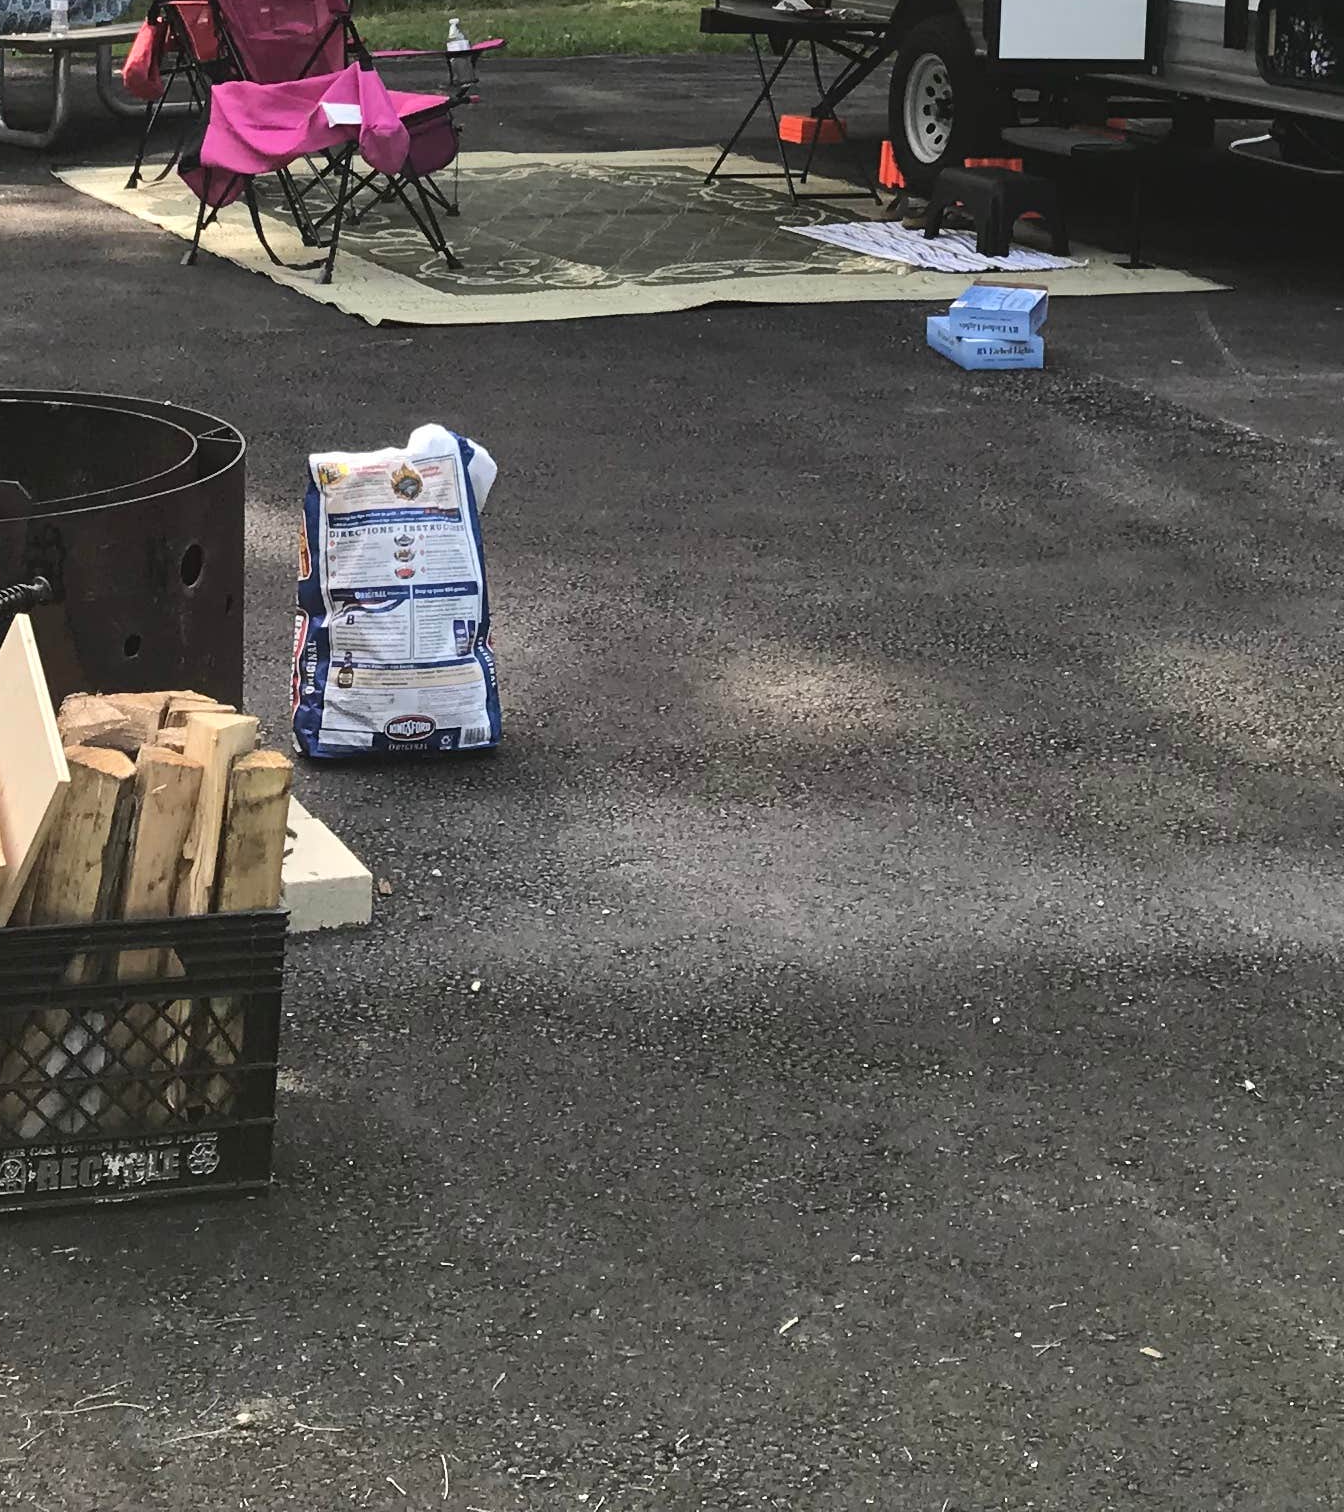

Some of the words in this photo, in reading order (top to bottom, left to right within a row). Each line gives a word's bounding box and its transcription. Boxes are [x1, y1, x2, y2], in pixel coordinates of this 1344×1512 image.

[329, 525, 394, 538] DIRECTIONS
[305, 640, 317, 695] ORIGINAL
[389, 719, 431, 736] KINGSFORD
[36, 1148, 180, 1191] RECYCLE
